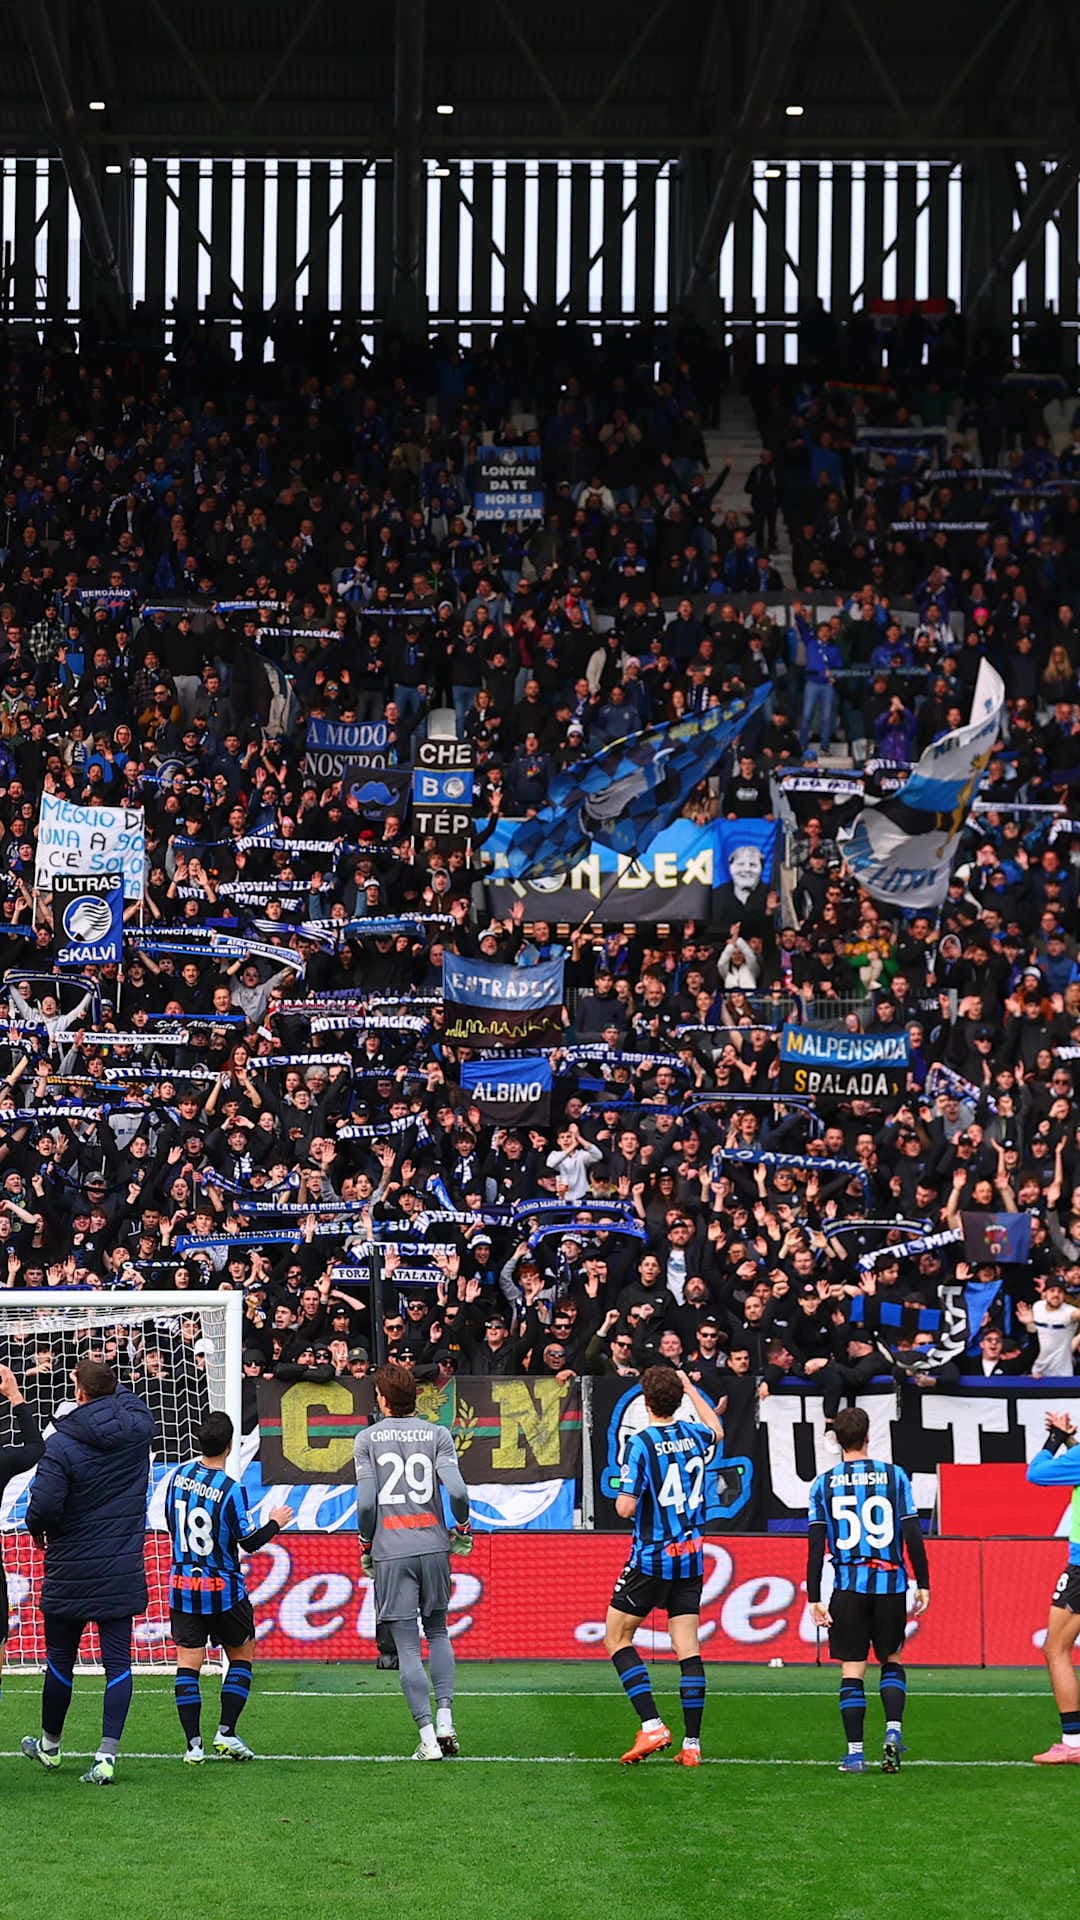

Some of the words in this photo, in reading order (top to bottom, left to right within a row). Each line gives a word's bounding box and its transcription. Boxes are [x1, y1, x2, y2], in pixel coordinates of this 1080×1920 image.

[481, 465, 536, 477] LONTAN
[489, 480, 508, 490] DA
[511, 480, 528, 490] TE
[484, 494, 517, 505] NON
[519, 494, 533, 504] SI
[508, 509, 542, 520] STAR
[306, 723, 320, 743] A
[325, 723, 388, 747] MODO
[419, 743, 472, 765] CHE
[41, 797, 116, 828] MEGLIO
[125, 811, 144, 831] DI
[416, 808, 470, 834] TÉP
[41, 828, 80, 849] UNA
[90, 832, 106, 851] A
[113, 833, 145, 852] 90
[284, 837, 335, 852] MAGICH
[90, 854, 143, 874] SOLO
[55, 876, 121, 892] ULTRAS
[58, 943, 117, 963] SKALVÌ
[786, 1031, 907, 1063] MALPENSADA
[472, 1081, 543, 1103] ALBINO
[794, 1069, 889, 1095] SBALADA
[338, 1269, 370, 1279] FORZ
[491, 1379, 570, 1469] N
[376, 1451, 434, 1506] 29
[657, 1455, 704, 1515] 42
[174, 1498, 215, 1557] 18
[831, 1494, 895, 1551] 59
